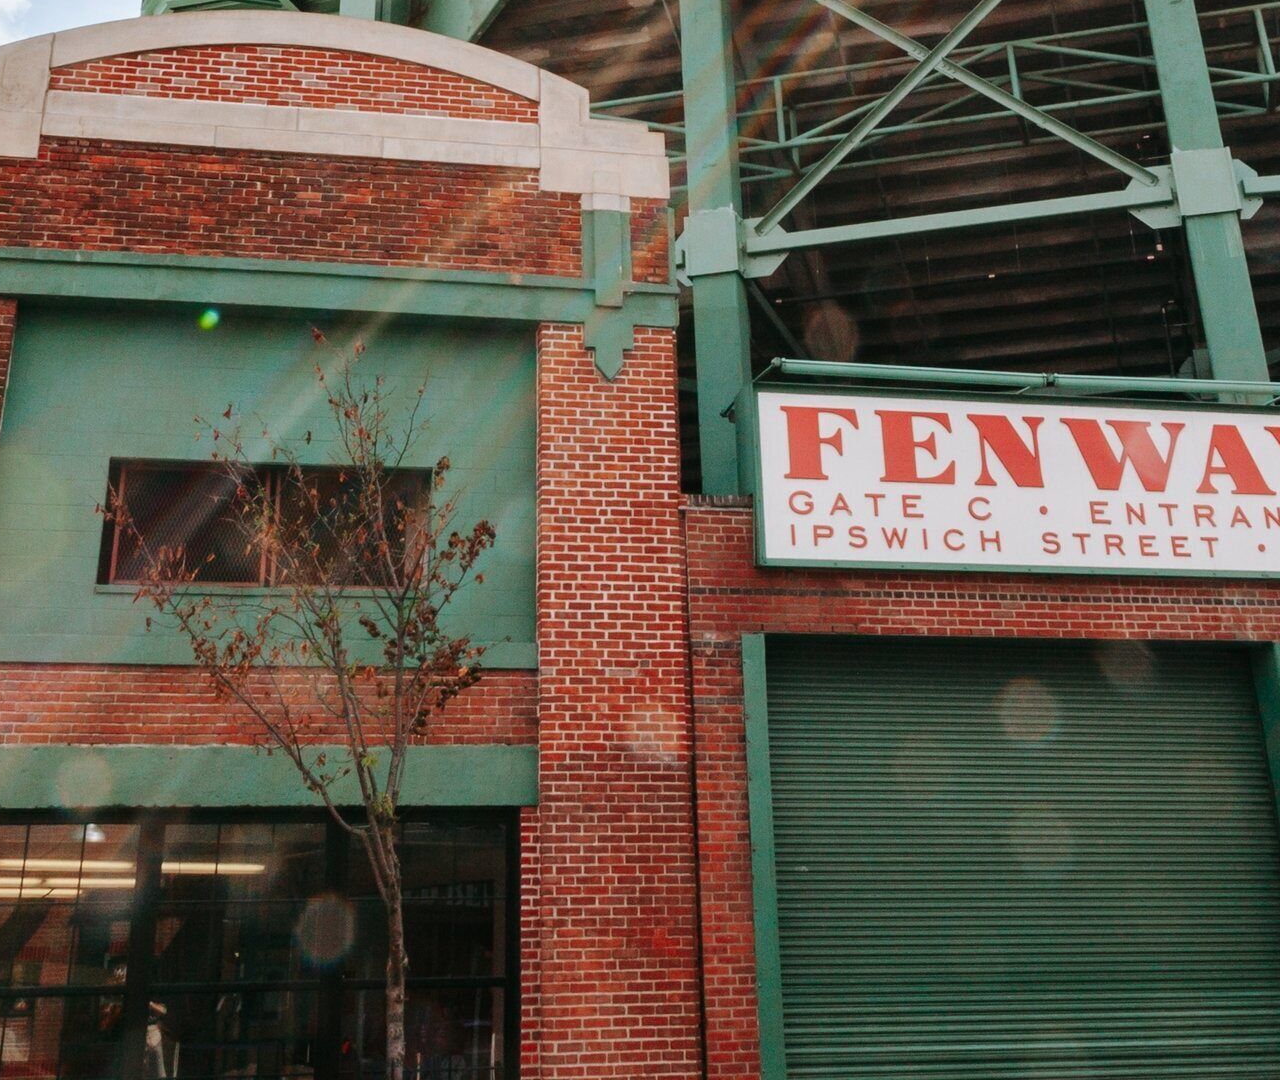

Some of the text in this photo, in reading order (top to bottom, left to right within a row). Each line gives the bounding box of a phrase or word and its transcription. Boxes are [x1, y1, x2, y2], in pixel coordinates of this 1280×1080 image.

[788, 490, 924, 519] GATE
[968, 496, 993, 521] C
[791, 524, 1001, 553] IPSWICH
[1042, 532, 1219, 559] STREET
